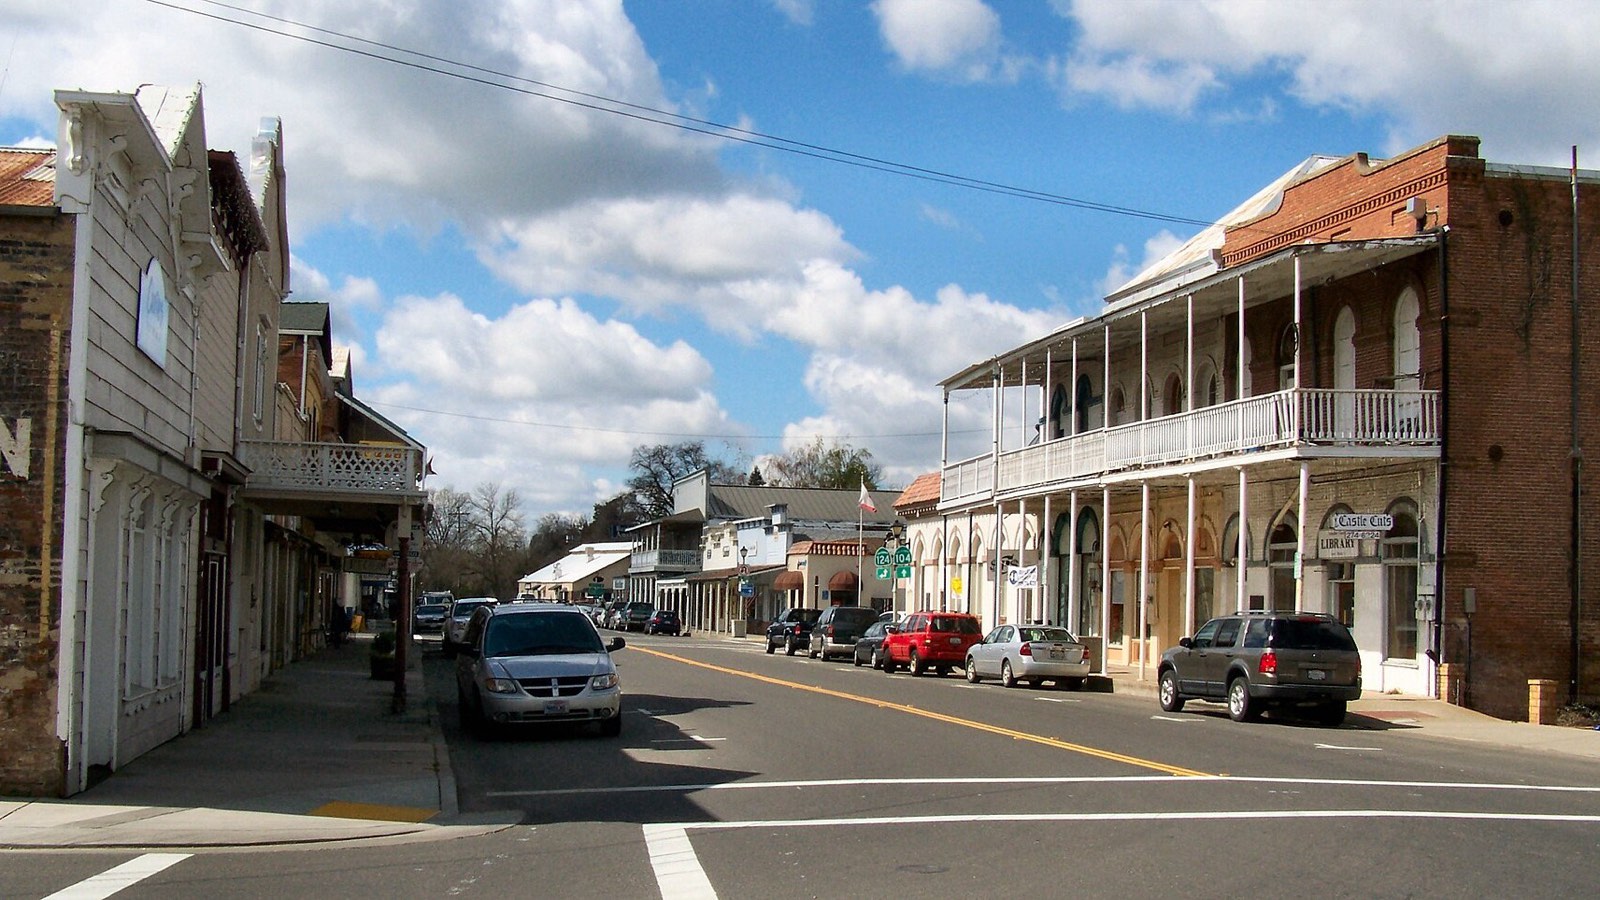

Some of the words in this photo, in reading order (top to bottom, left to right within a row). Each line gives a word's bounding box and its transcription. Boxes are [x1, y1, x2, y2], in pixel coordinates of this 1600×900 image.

[1338, 515, 1367, 527] Castle
[1369, 515, 1392, 527] Cuts
[1321, 538, 1354, 549] LIBRARY
[877, 554, 890, 564] 124
[895, 553, 911, 563] 104
